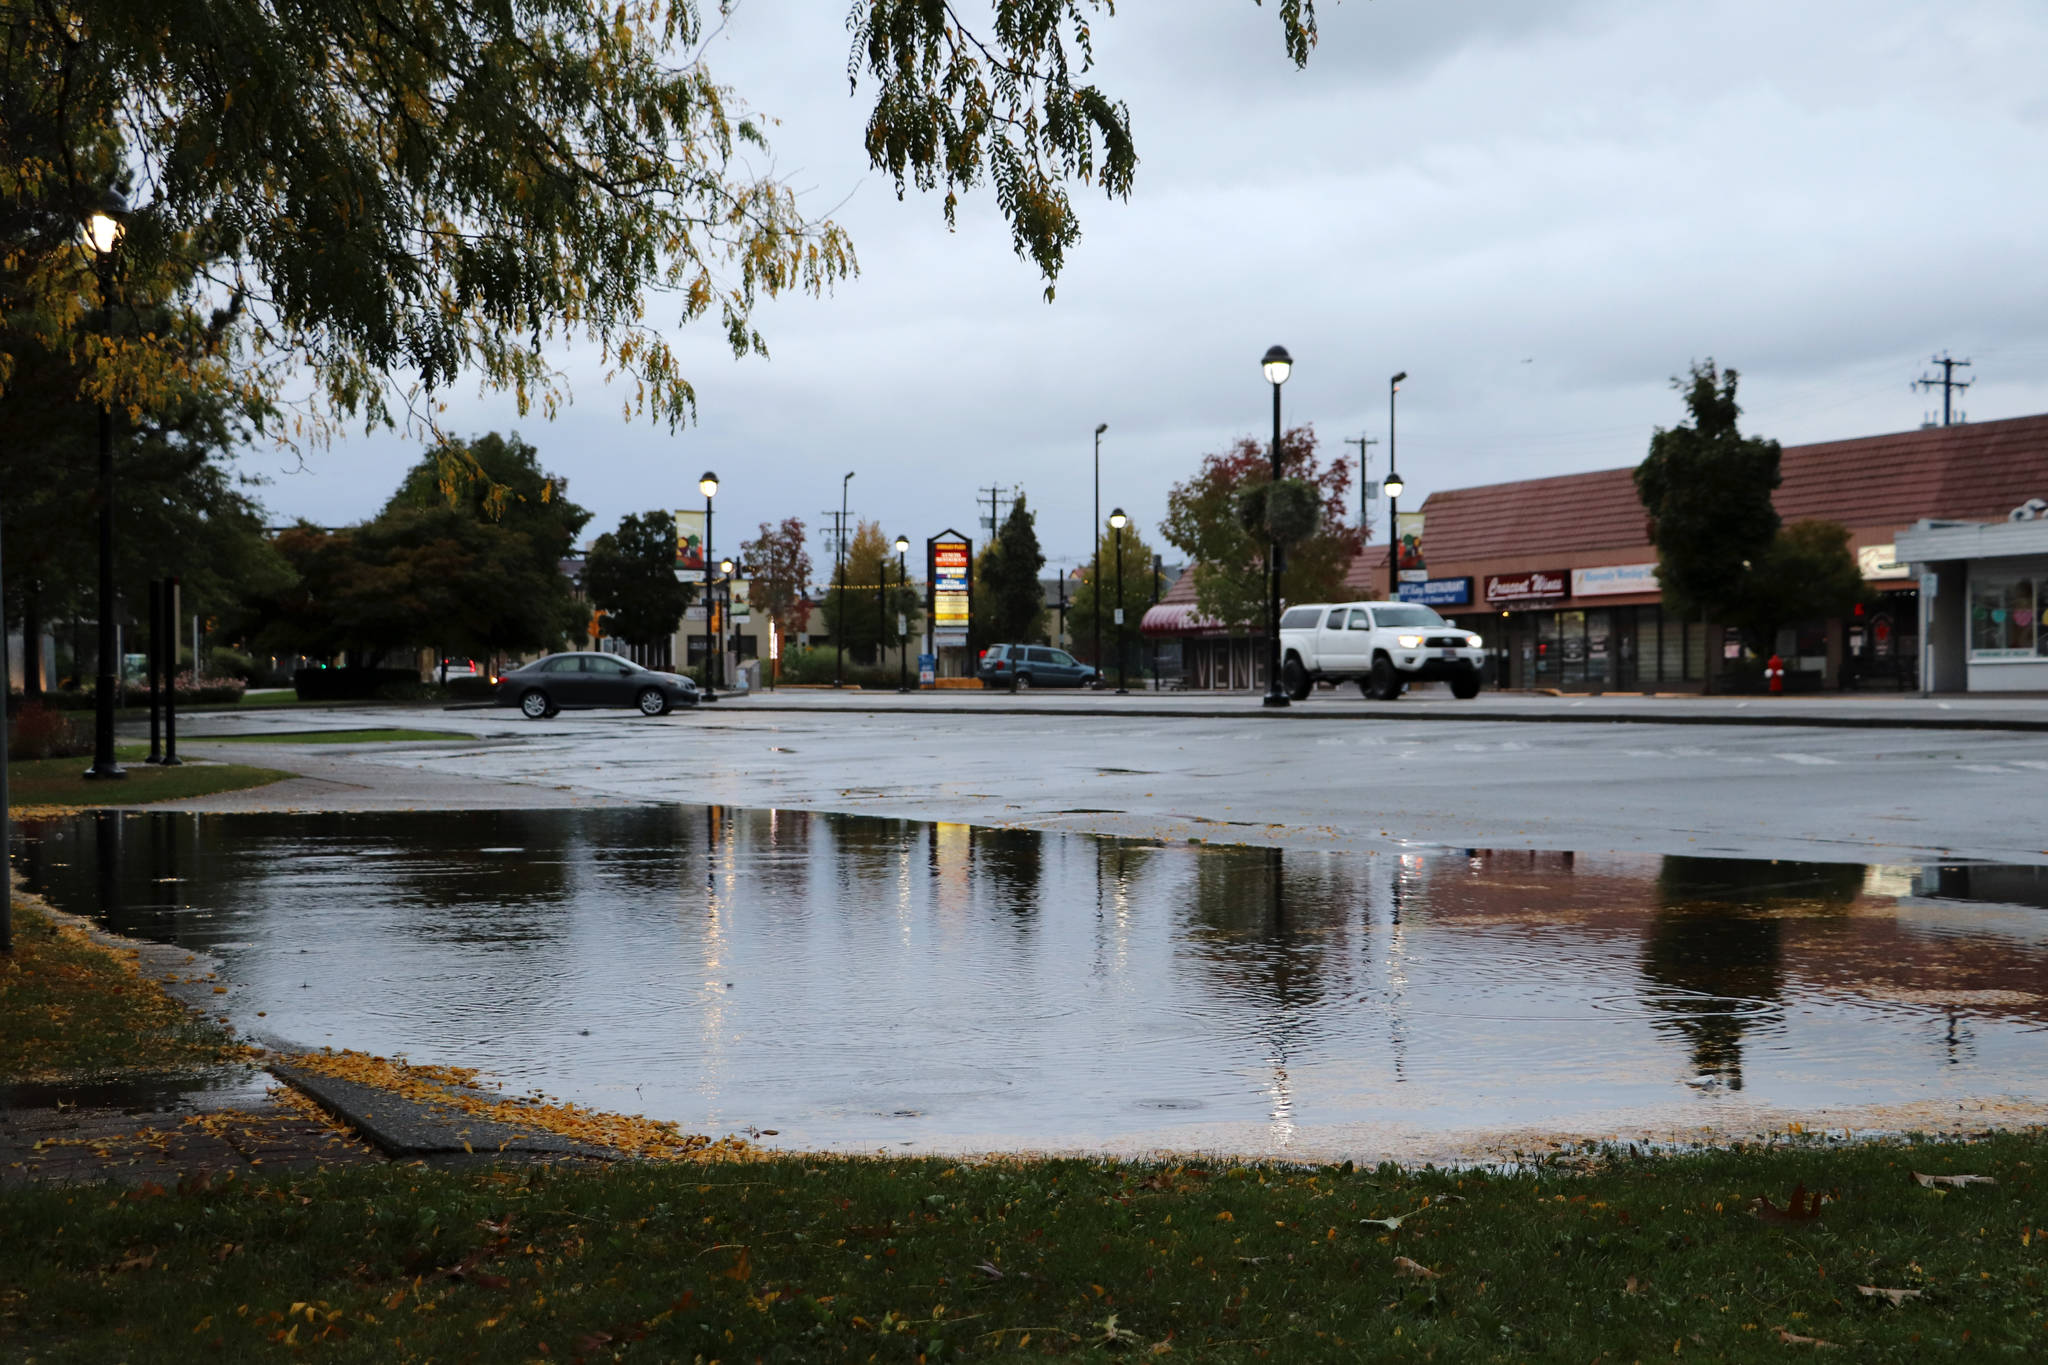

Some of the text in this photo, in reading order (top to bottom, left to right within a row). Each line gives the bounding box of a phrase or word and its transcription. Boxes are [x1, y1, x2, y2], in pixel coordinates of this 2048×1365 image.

[1424, 580, 1465, 594] RESTAURANT
[1487, 573, 1563, 597] Crescent Wines
